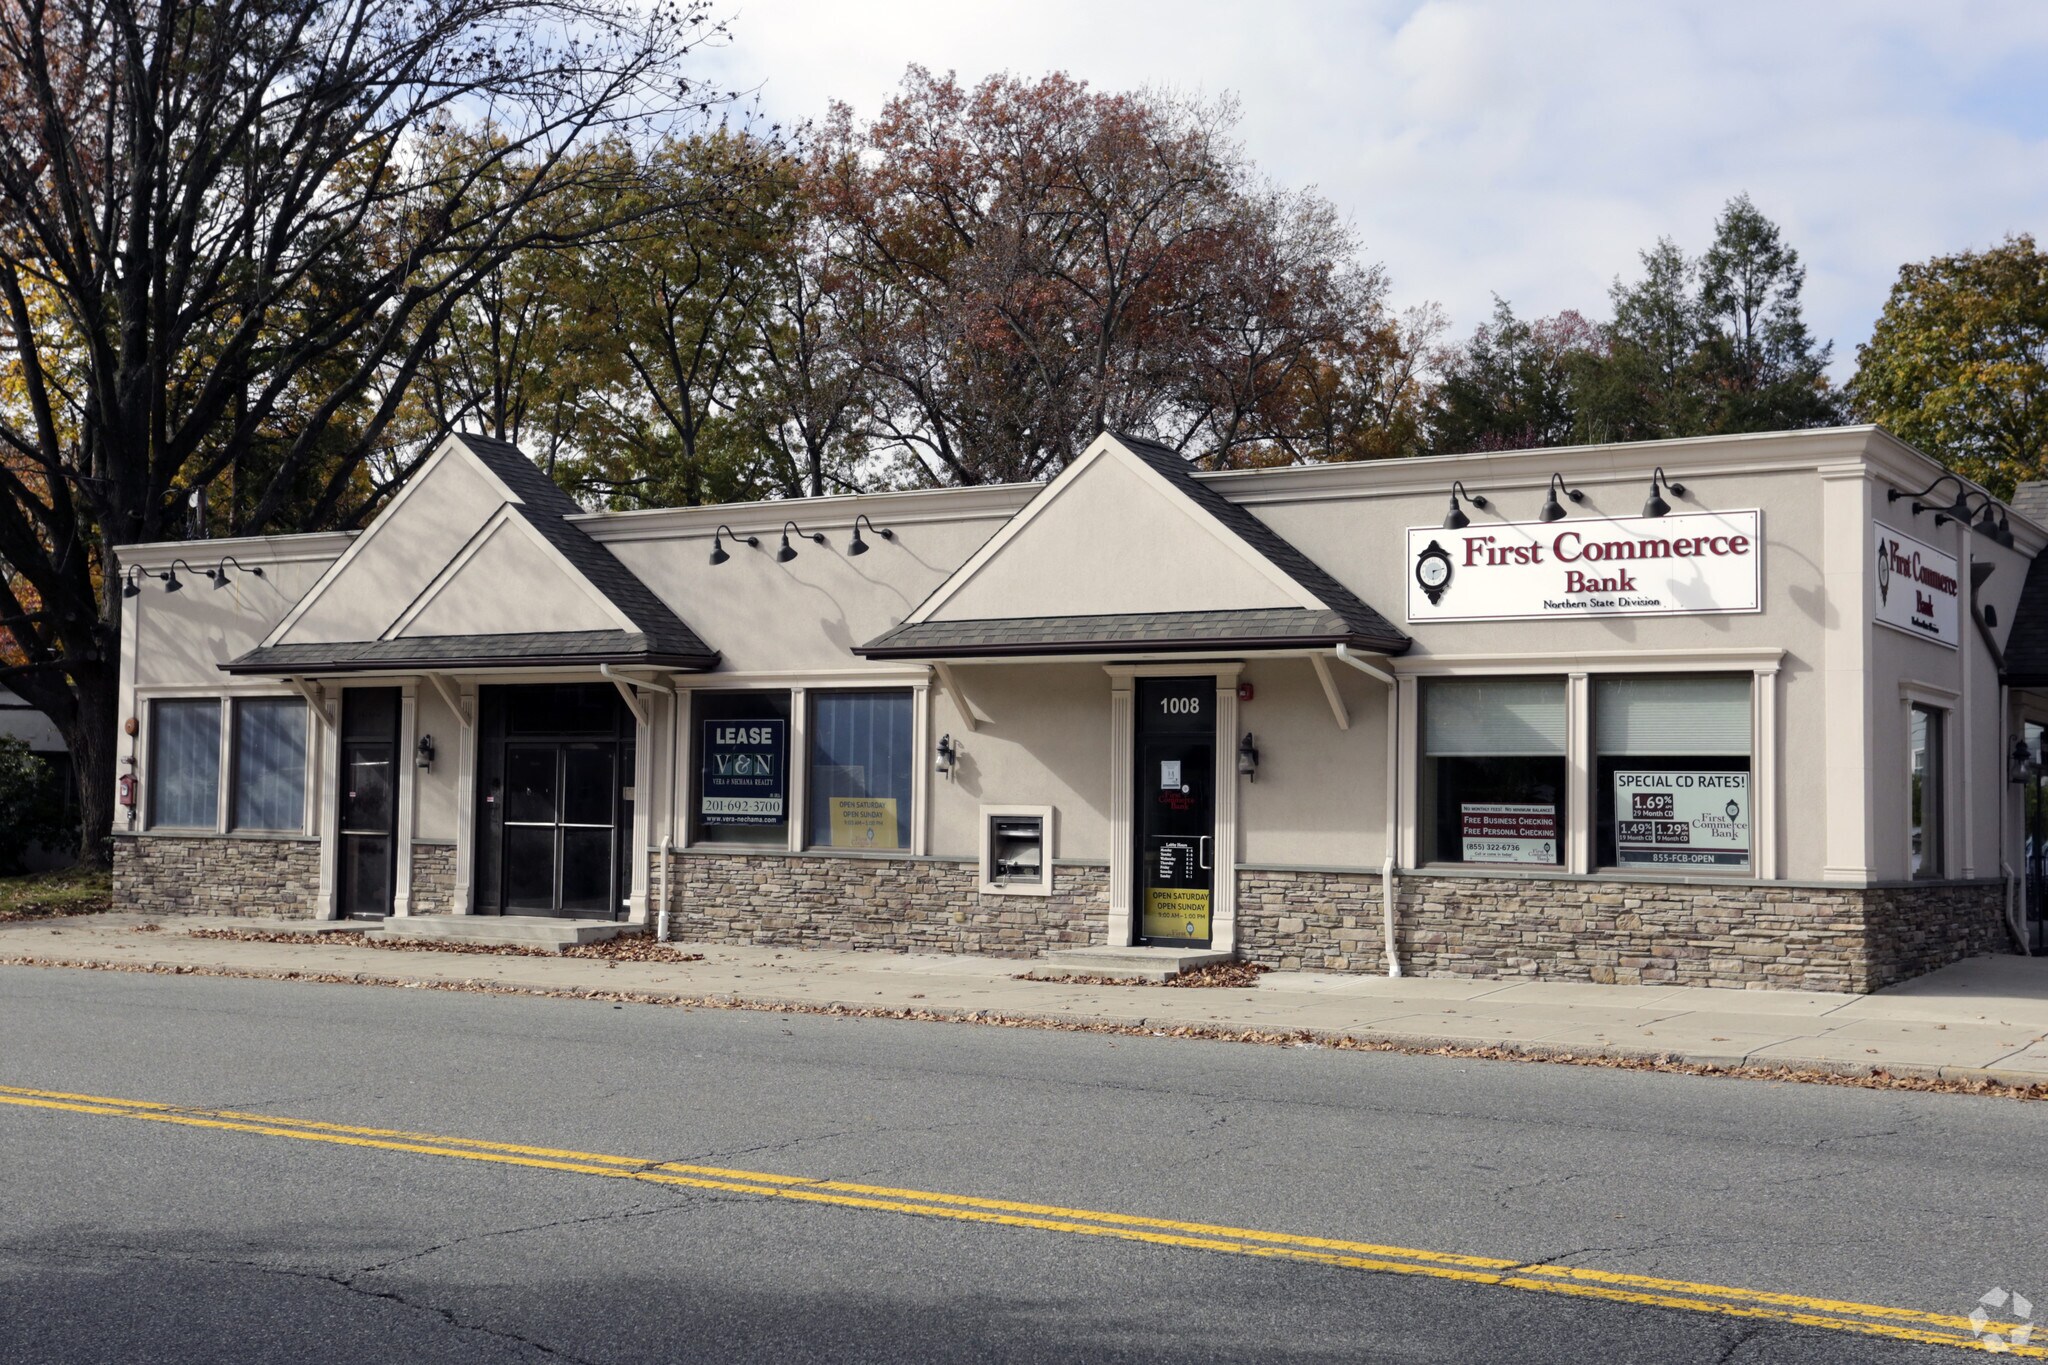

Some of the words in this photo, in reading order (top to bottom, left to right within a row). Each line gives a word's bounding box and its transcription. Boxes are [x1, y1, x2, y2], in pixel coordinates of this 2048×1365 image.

[1462, 536, 1543, 567] First
[1553, 532, 1749, 563] Commerce
[1889, 540, 1912, 578] First
[1565, 569, 1637, 594] Bank
[1544, 599, 1586, 610] Northern
[1590, 598, 1615, 608] State
[1618, 597, 1660, 608] Division
[1160, 698, 1200, 713] 1008
[716, 728, 772, 744] LEASE
[1619, 775, 1672, 787] SPECIAL
[1676, 776, 1694, 787] CD
[1699, 776, 1745, 788] RATES!
[1634, 796, 1672, 809] 1.69%
[1484, 816, 1516, 825] BUSINESS
[1519, 817, 1553, 825] CHECKING
[1701, 813, 1725, 822] First
[1621, 823, 1652, 834] 1.49%
[1657, 824, 1688, 835] 1.29%
[1692, 819, 1747, 829] Commerce
[1483, 827, 1517, 836] PERSONAL
[1712, 828, 1738, 837] Bank
[1653, 854, 1714, 863] 855-FCB-OPEN
